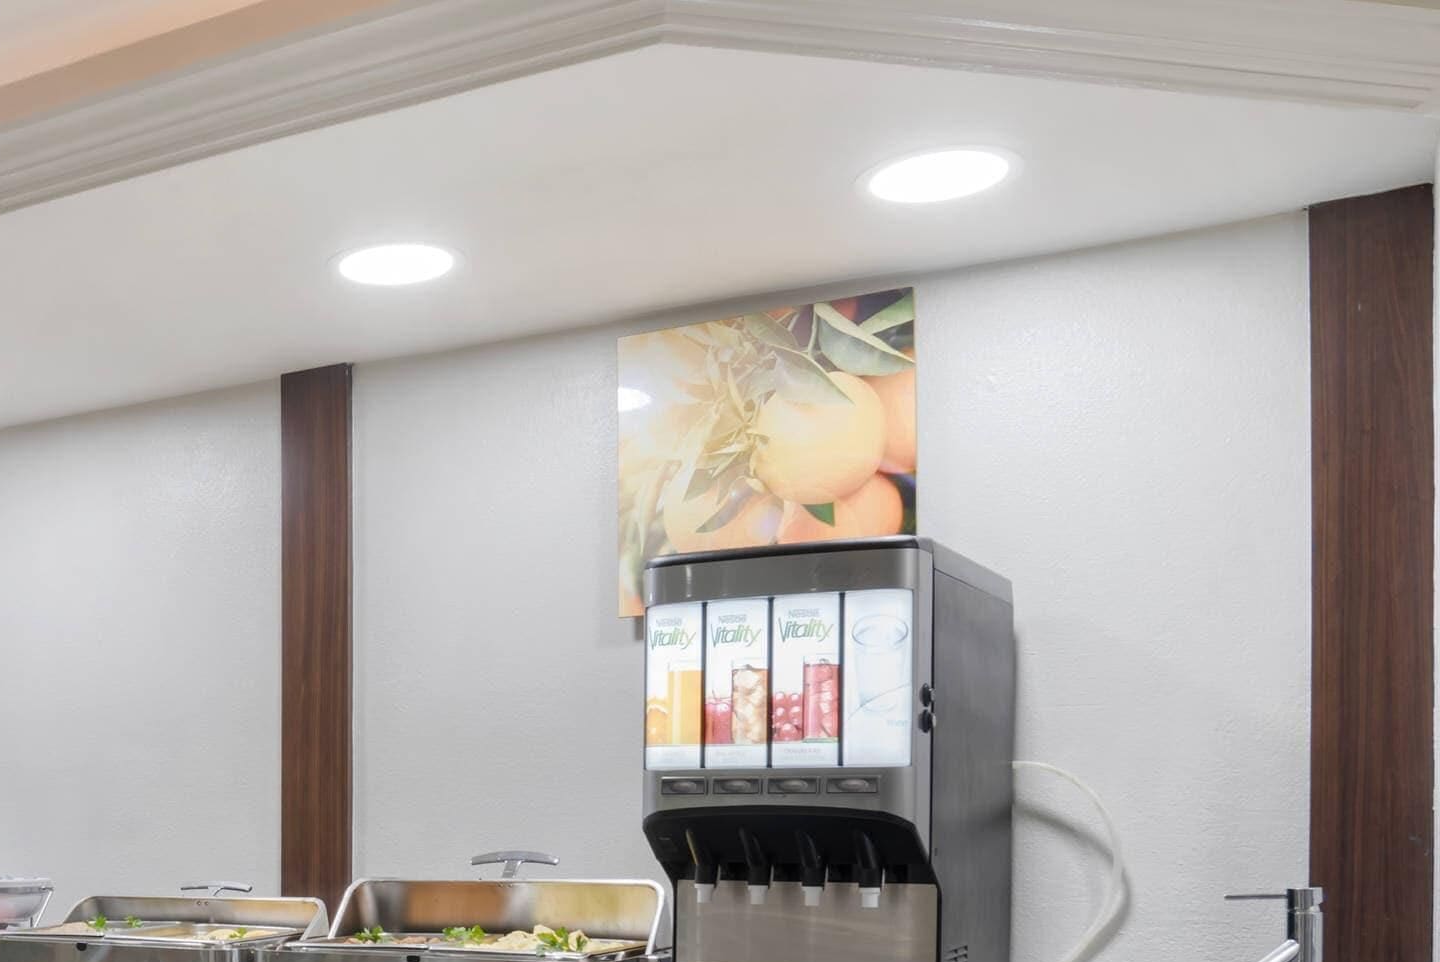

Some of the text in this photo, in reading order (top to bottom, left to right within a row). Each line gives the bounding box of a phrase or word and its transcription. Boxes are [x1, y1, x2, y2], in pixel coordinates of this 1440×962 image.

[648, 627, 697, 650] Vitality
[711, 623, 762, 649] Vitality
[778, 617, 835, 643] Vitality
